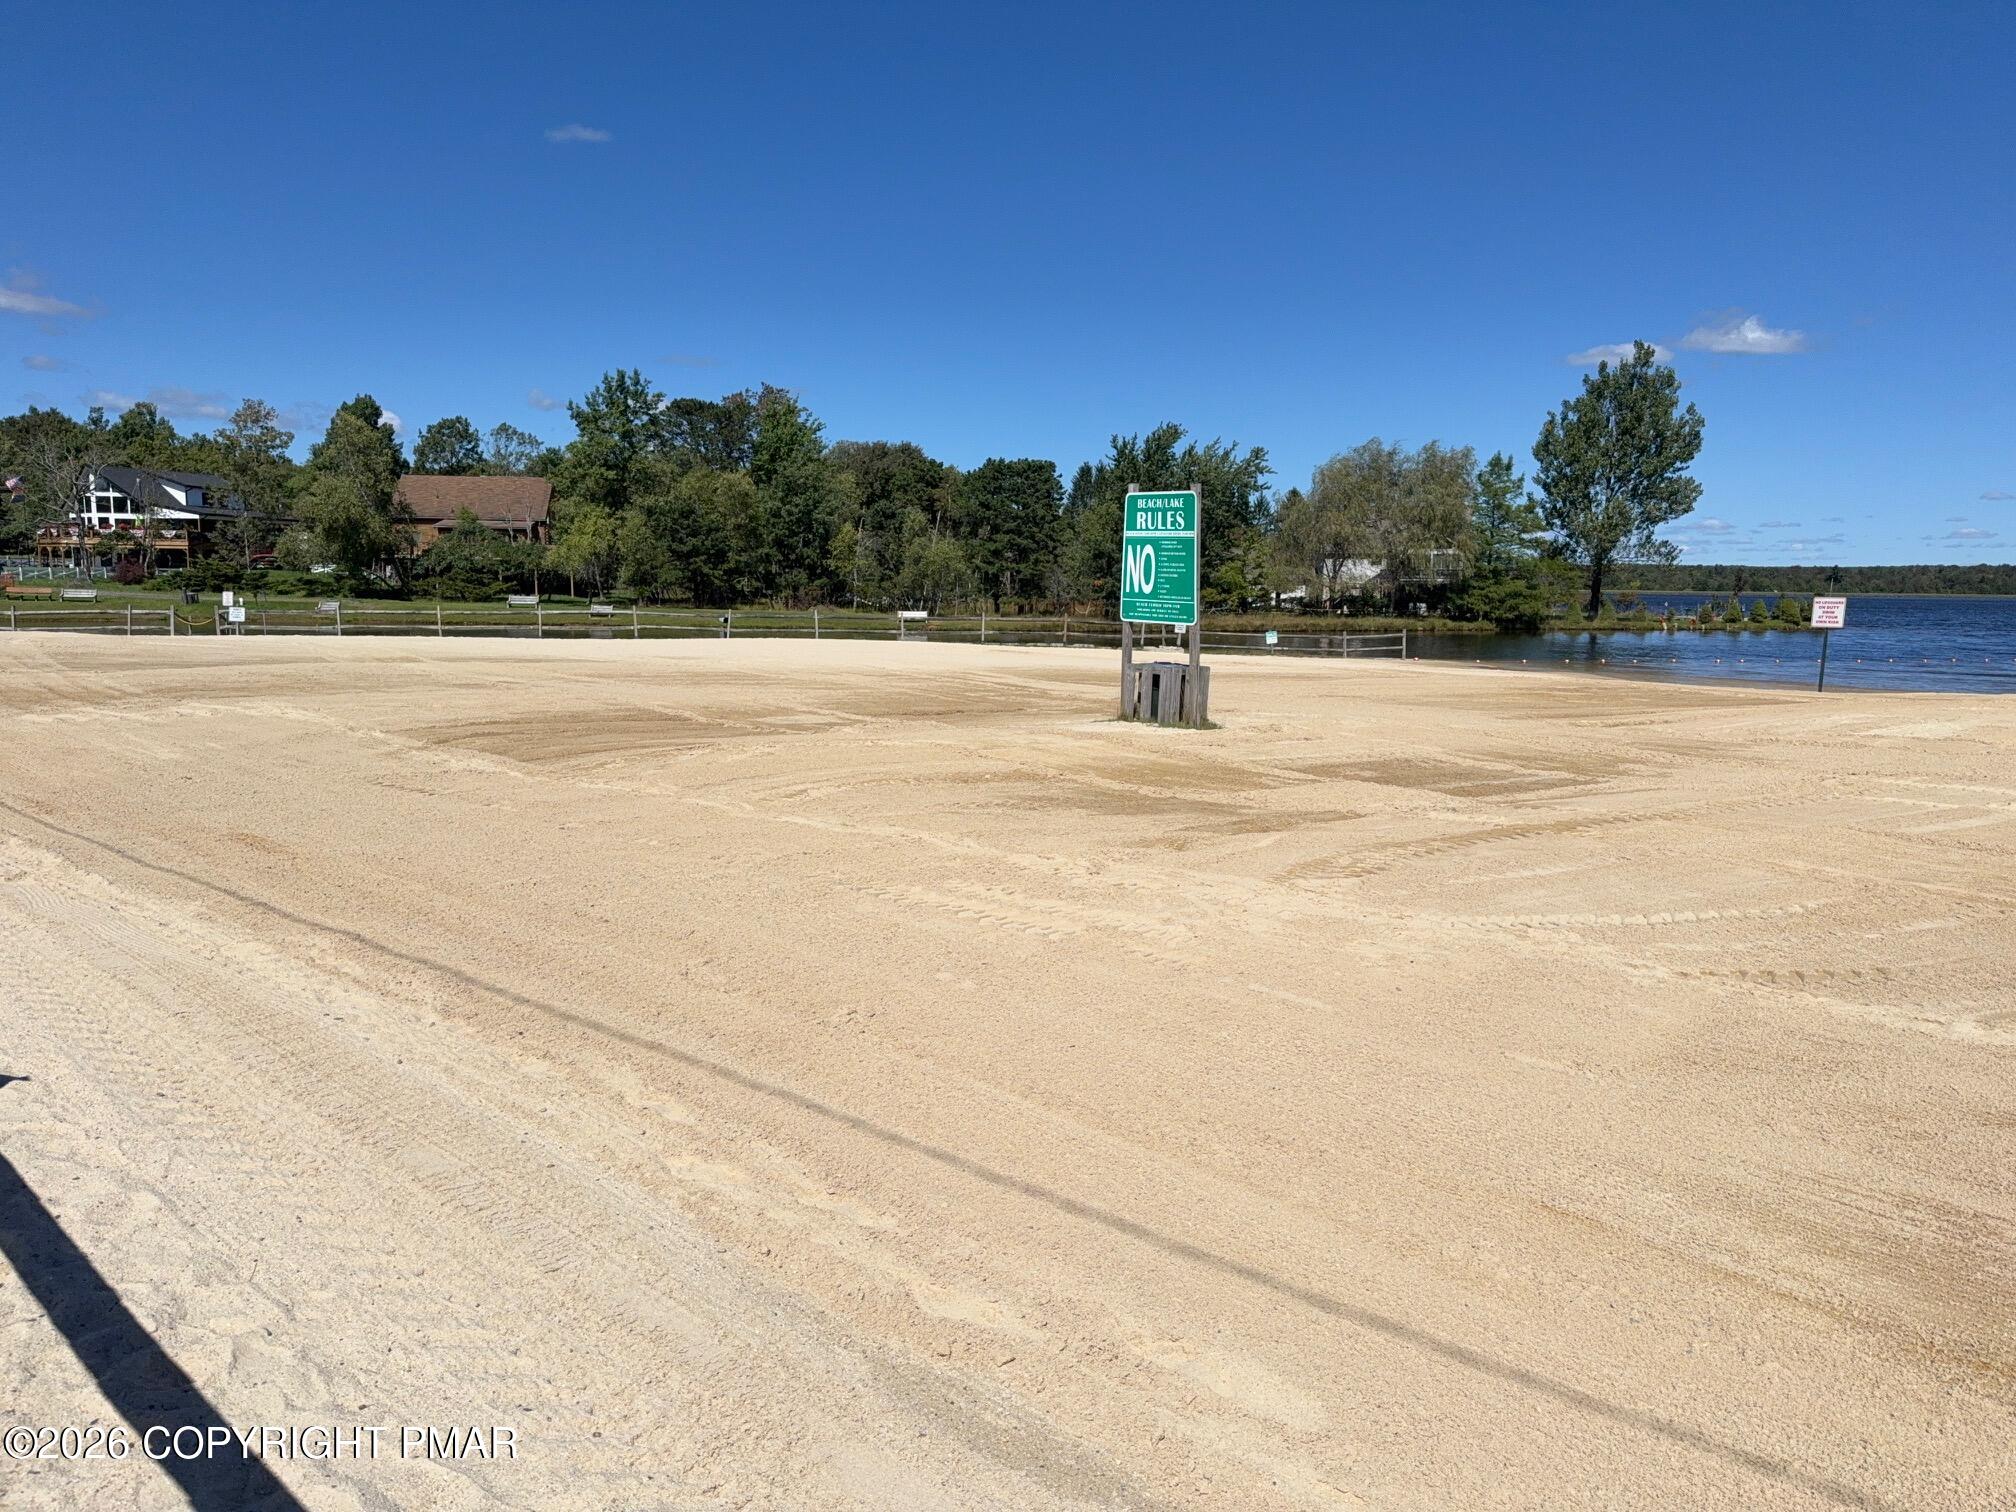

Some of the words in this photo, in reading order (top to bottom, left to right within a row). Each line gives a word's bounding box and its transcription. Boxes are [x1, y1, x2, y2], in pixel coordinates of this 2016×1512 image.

[1137, 497, 1185, 509] BEACH/LAKE
[1136, 511, 1185, 530] RULES
[1125, 544, 1156, 595] NO
